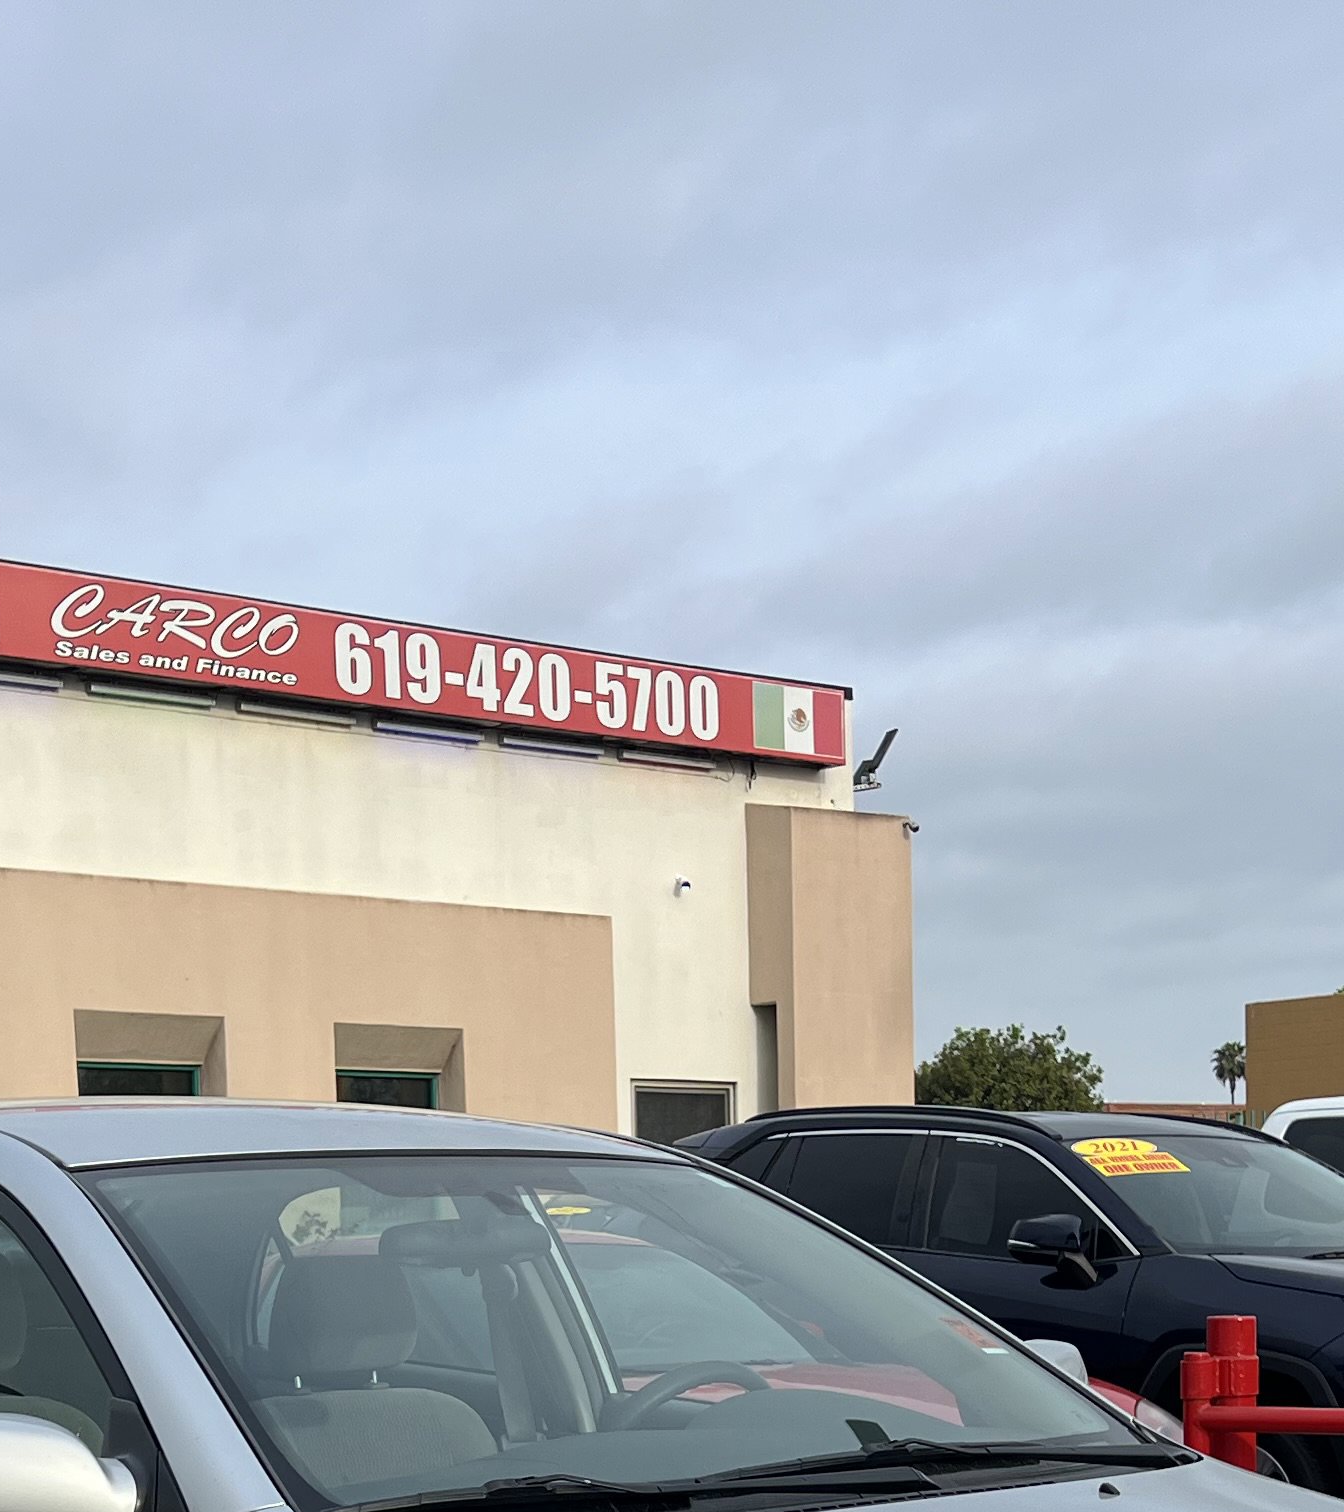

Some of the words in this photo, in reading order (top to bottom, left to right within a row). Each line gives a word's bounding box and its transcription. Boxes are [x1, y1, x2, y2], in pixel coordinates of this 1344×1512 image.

[50, 583, 299, 658] CARCO
[55, 640, 131, 664] Sales
[138, 653, 189, 671] and
[196, 657, 298, 686] Finance
[334, 622, 719, 741] 619-420-5700
[1088, 1141, 1139, 1153] 2021
[1103, 1163, 1133, 1173] ONE
[1133, 1161, 1181, 1171] OWNER
